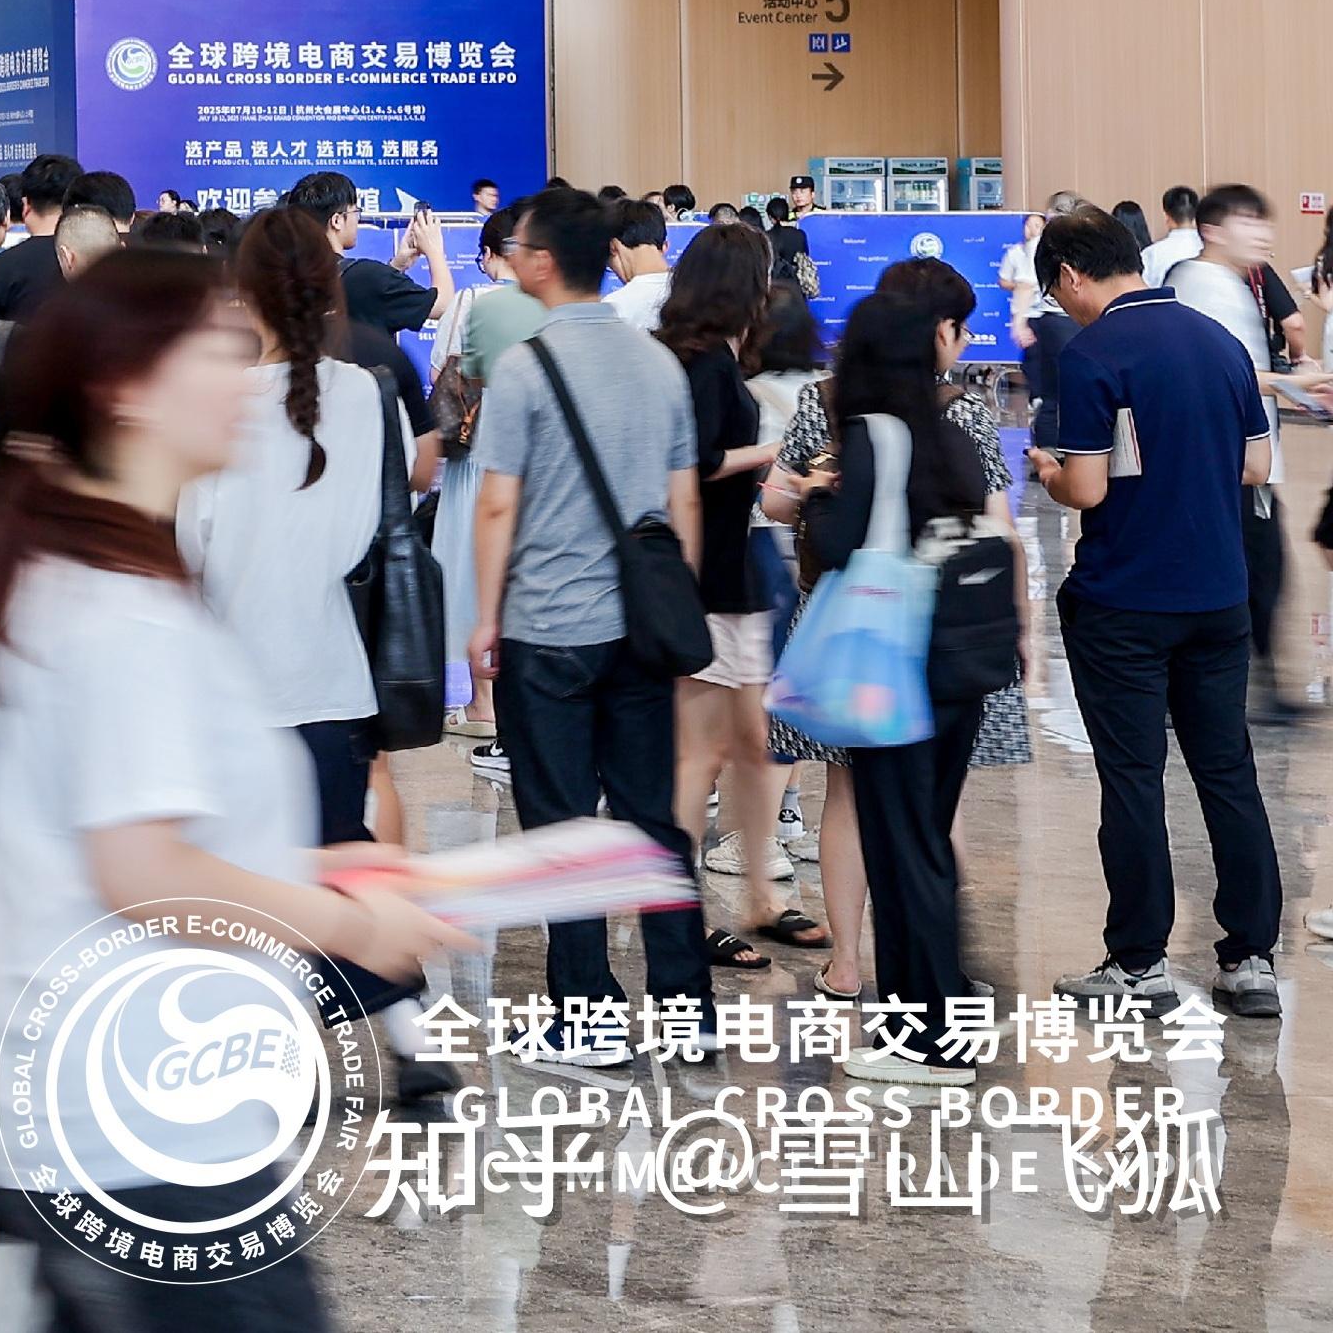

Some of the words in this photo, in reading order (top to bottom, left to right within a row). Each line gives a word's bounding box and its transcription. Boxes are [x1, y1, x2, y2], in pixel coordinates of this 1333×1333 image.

[738, 12, 773, 24] Event
[776, 12, 818, 24] Center
[167, 41, 516, 69] 全球跨境电商交易博览会
[168, 72, 223, 85] GLOBAL
[226, 72, 272, 85] CROSS
[276, 72, 332, 85] BORDER
[337, 72, 428, 84] E-COMMERCE
[431, 72, 476, 84] TRADE
[480, 72, 516, 84] EXPO
[185, 140, 242, 158] 选产品
[251, 140, 307, 158] 选人才
[317, 140, 374, 158] 选市场
[381, 140, 438, 158] 选服务
